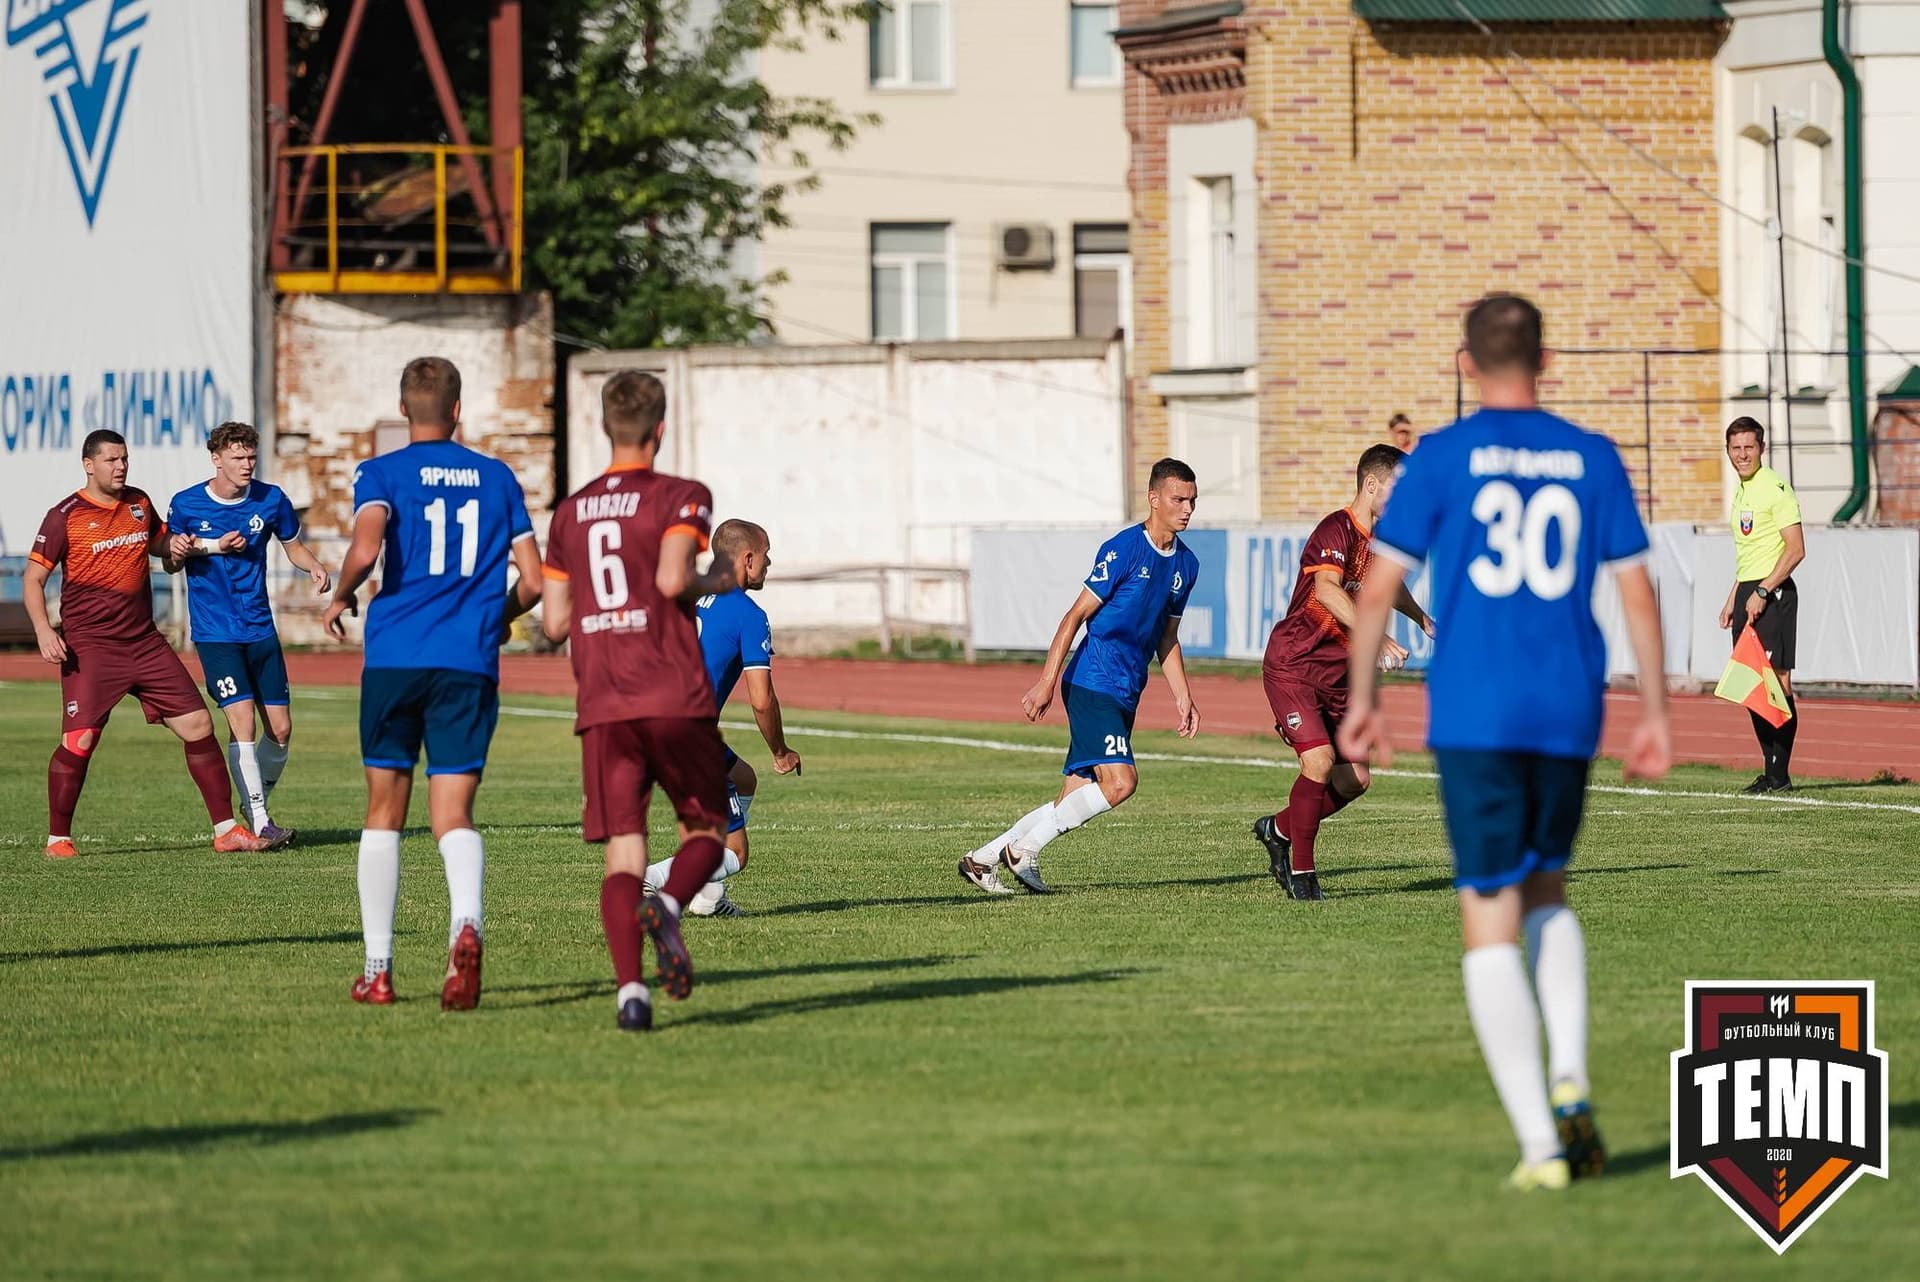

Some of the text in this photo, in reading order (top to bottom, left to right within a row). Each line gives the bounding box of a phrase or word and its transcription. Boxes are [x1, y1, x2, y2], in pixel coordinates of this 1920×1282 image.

[419, 466, 481, 487] ЯРКИН
[424, 497, 480, 577] 11
[1467, 479, 1582, 601] 30
[587, 519, 629, 610] 6
[216, 676, 238, 698] 33
[1105, 735, 1128, 756] 24
